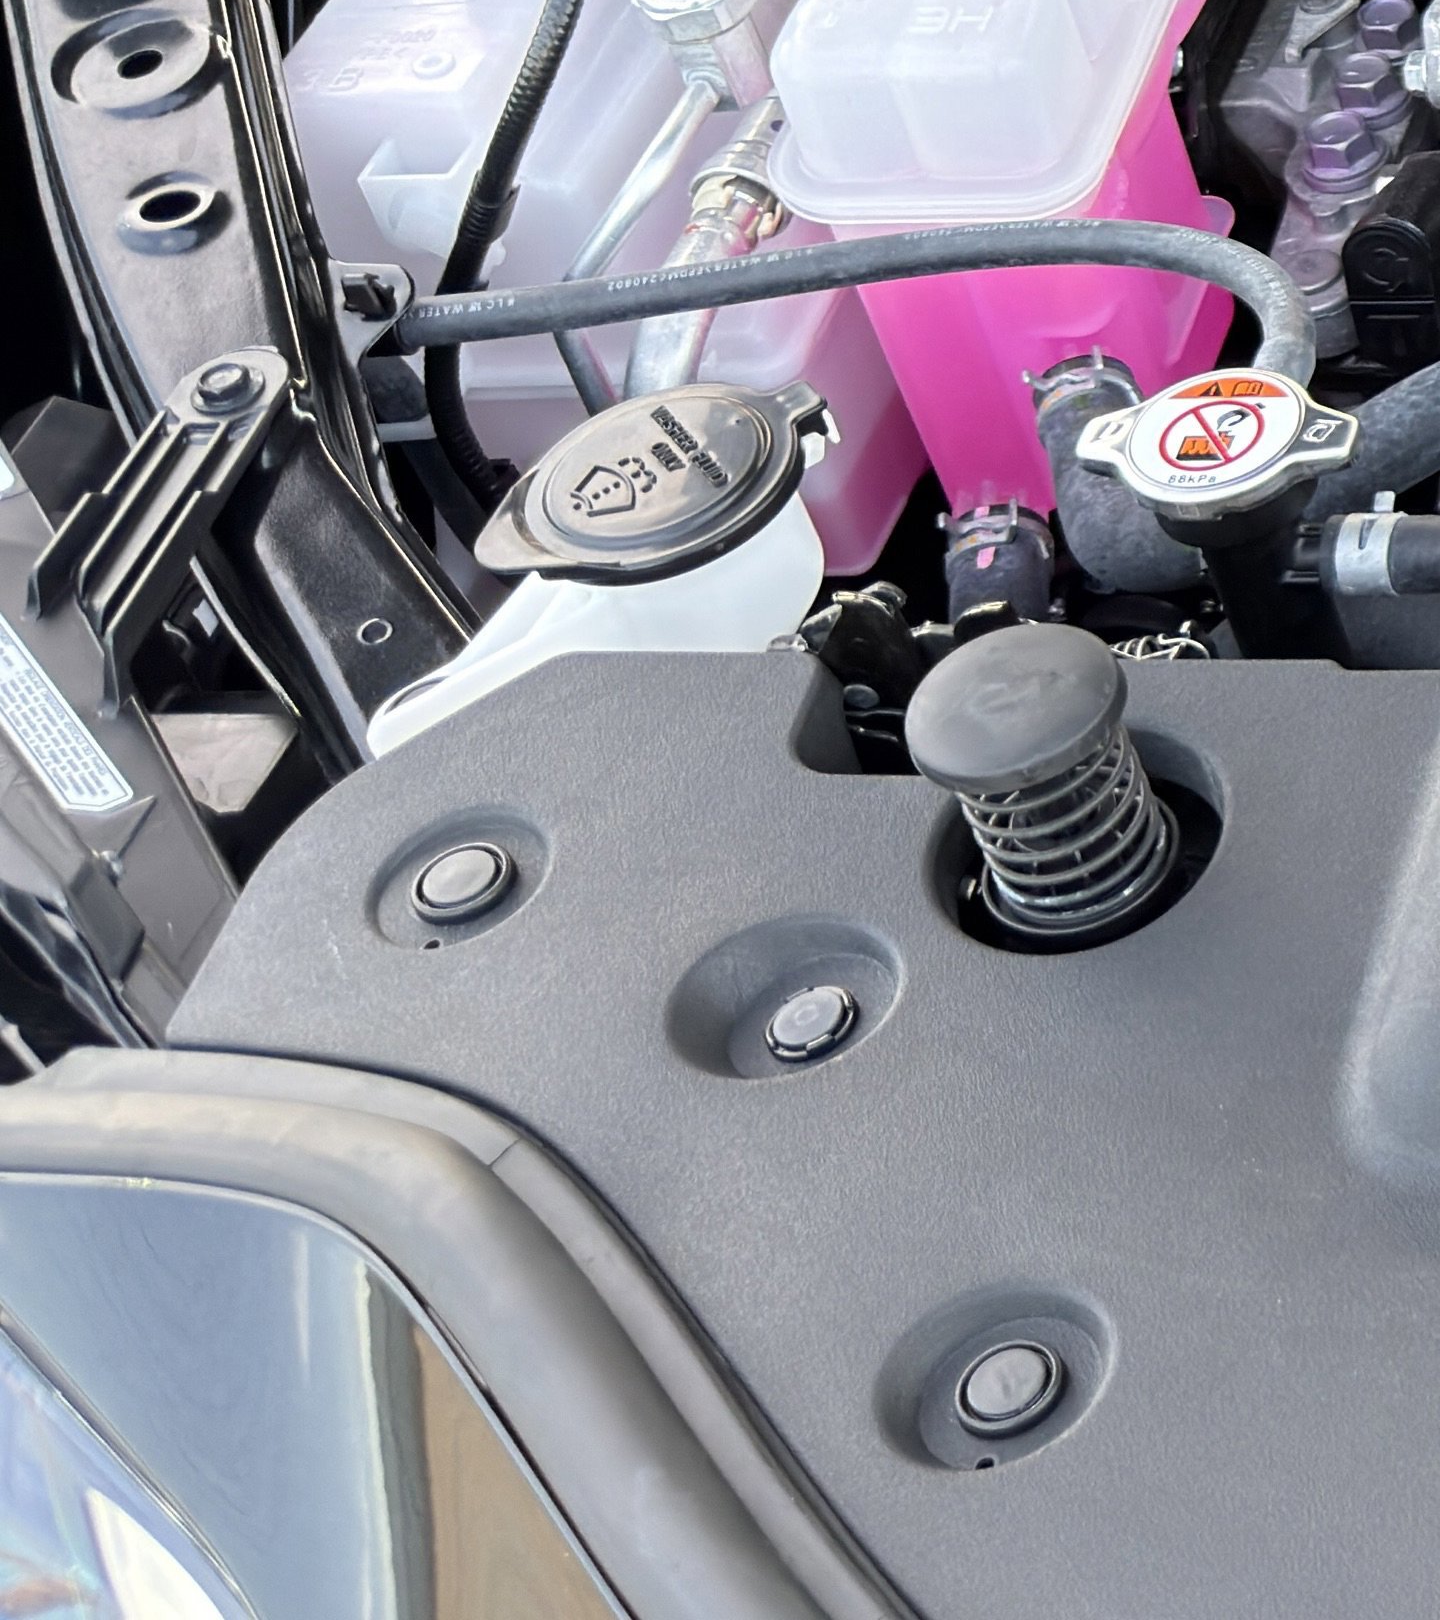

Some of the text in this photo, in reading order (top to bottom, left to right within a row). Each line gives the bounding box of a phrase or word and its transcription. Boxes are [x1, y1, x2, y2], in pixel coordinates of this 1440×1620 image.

[649, 404, 729, 488] WASHER FLUID
[650, 441, 687, 472] ONLY
[1167, 473, 1218, 485] 88kPa
